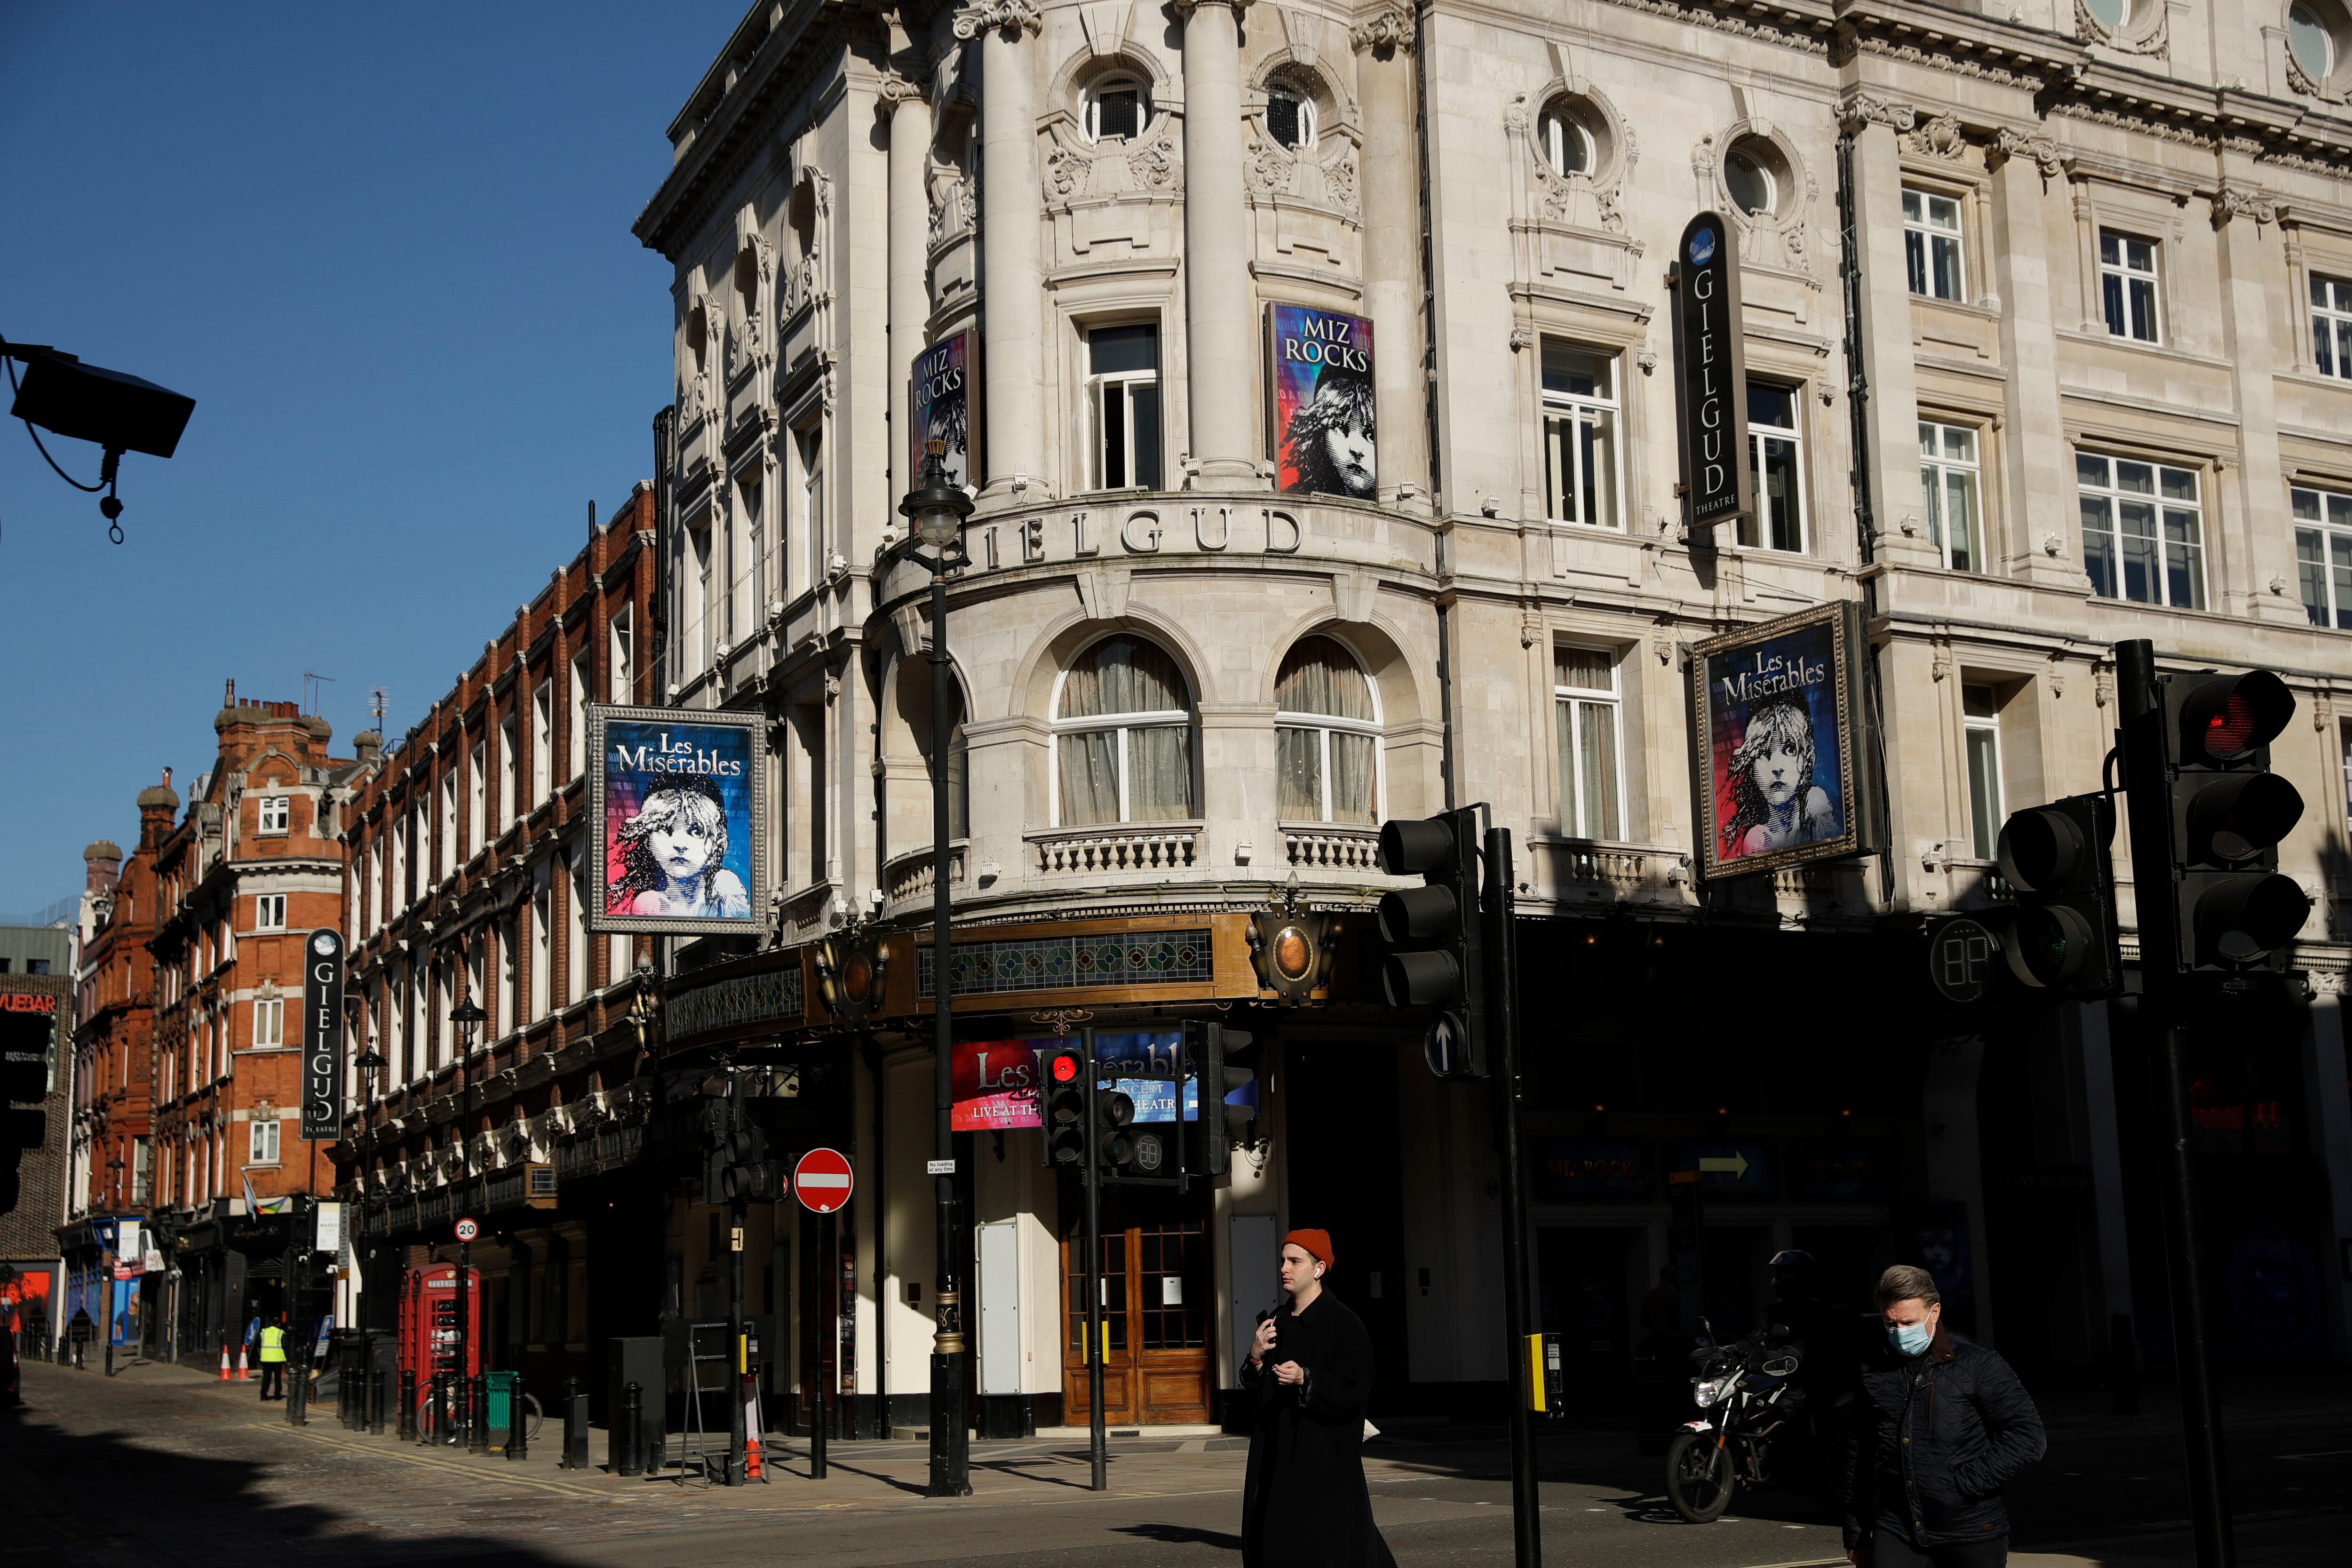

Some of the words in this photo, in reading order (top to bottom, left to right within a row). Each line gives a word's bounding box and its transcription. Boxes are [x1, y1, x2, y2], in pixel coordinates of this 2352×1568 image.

[1303, 316, 1350, 344] MIZ
[922, 348, 948, 382] MIZ
[1284, 337, 1367, 372] ROCKS
[915, 366, 961, 412] ROCKS
[1693, 269, 1724, 495] GIELGUD
[1695, 493, 1736, 516] THEATRE
[1756, 651, 1783, 676] Les
[1722, 655, 1825, 707] Misérables
[660, 732, 692, 755] Les
[616, 745, 742, 776] Misérables
[312, 962, 334, 1121] GIELGUD
[977, 1052, 1030, 1090] Les
[1102, 1084, 1164, 1095] ONCERT
[973, 1106, 999, 1118] LIVE
[1001, 1105, 1017, 1116] AT
[1133, 1098, 1175, 1111] HEATR
[459, 1225, 475, 1234] 20
